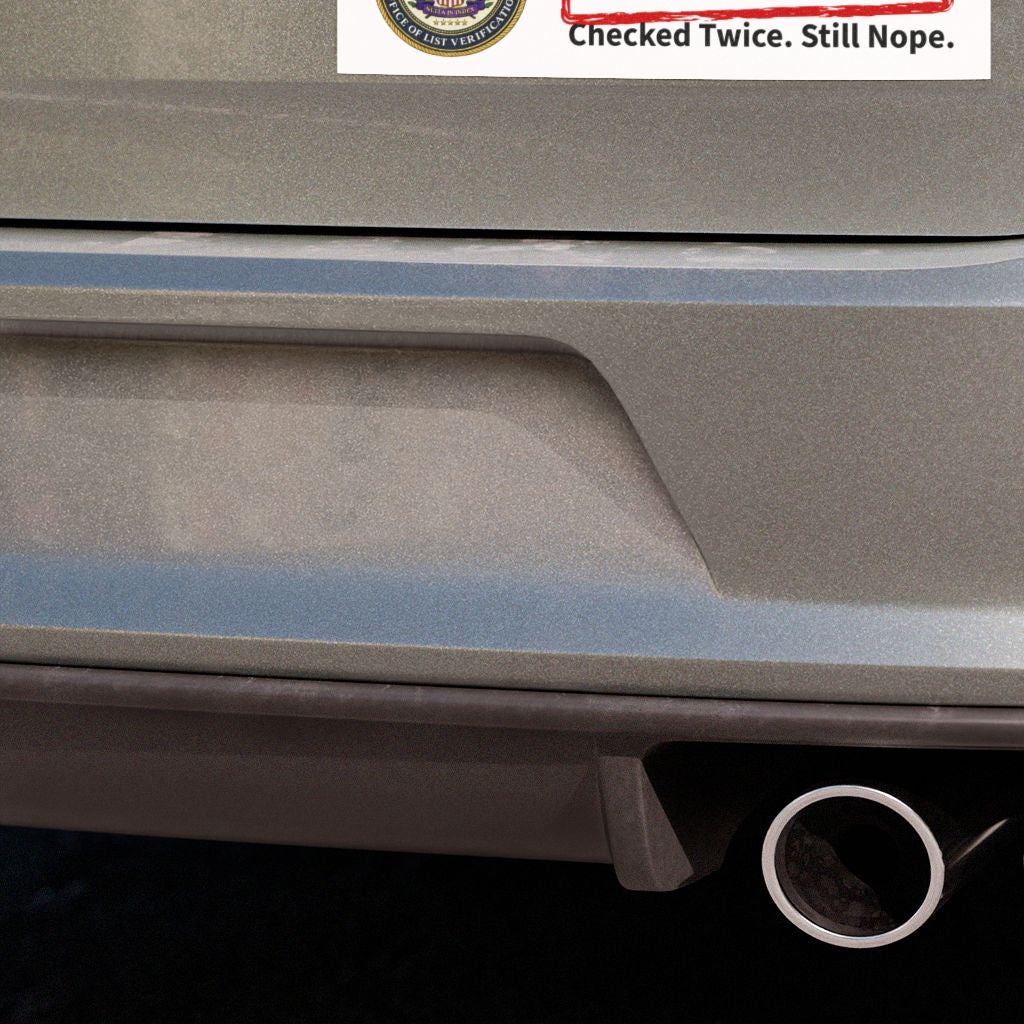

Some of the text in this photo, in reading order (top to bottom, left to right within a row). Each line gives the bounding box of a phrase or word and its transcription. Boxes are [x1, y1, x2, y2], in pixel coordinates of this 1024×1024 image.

[408, 25, 423, 37] OF
[423, 33, 448, 46] LIST
[568, 21, 954, 55] Checked Twice. Still Nope.
